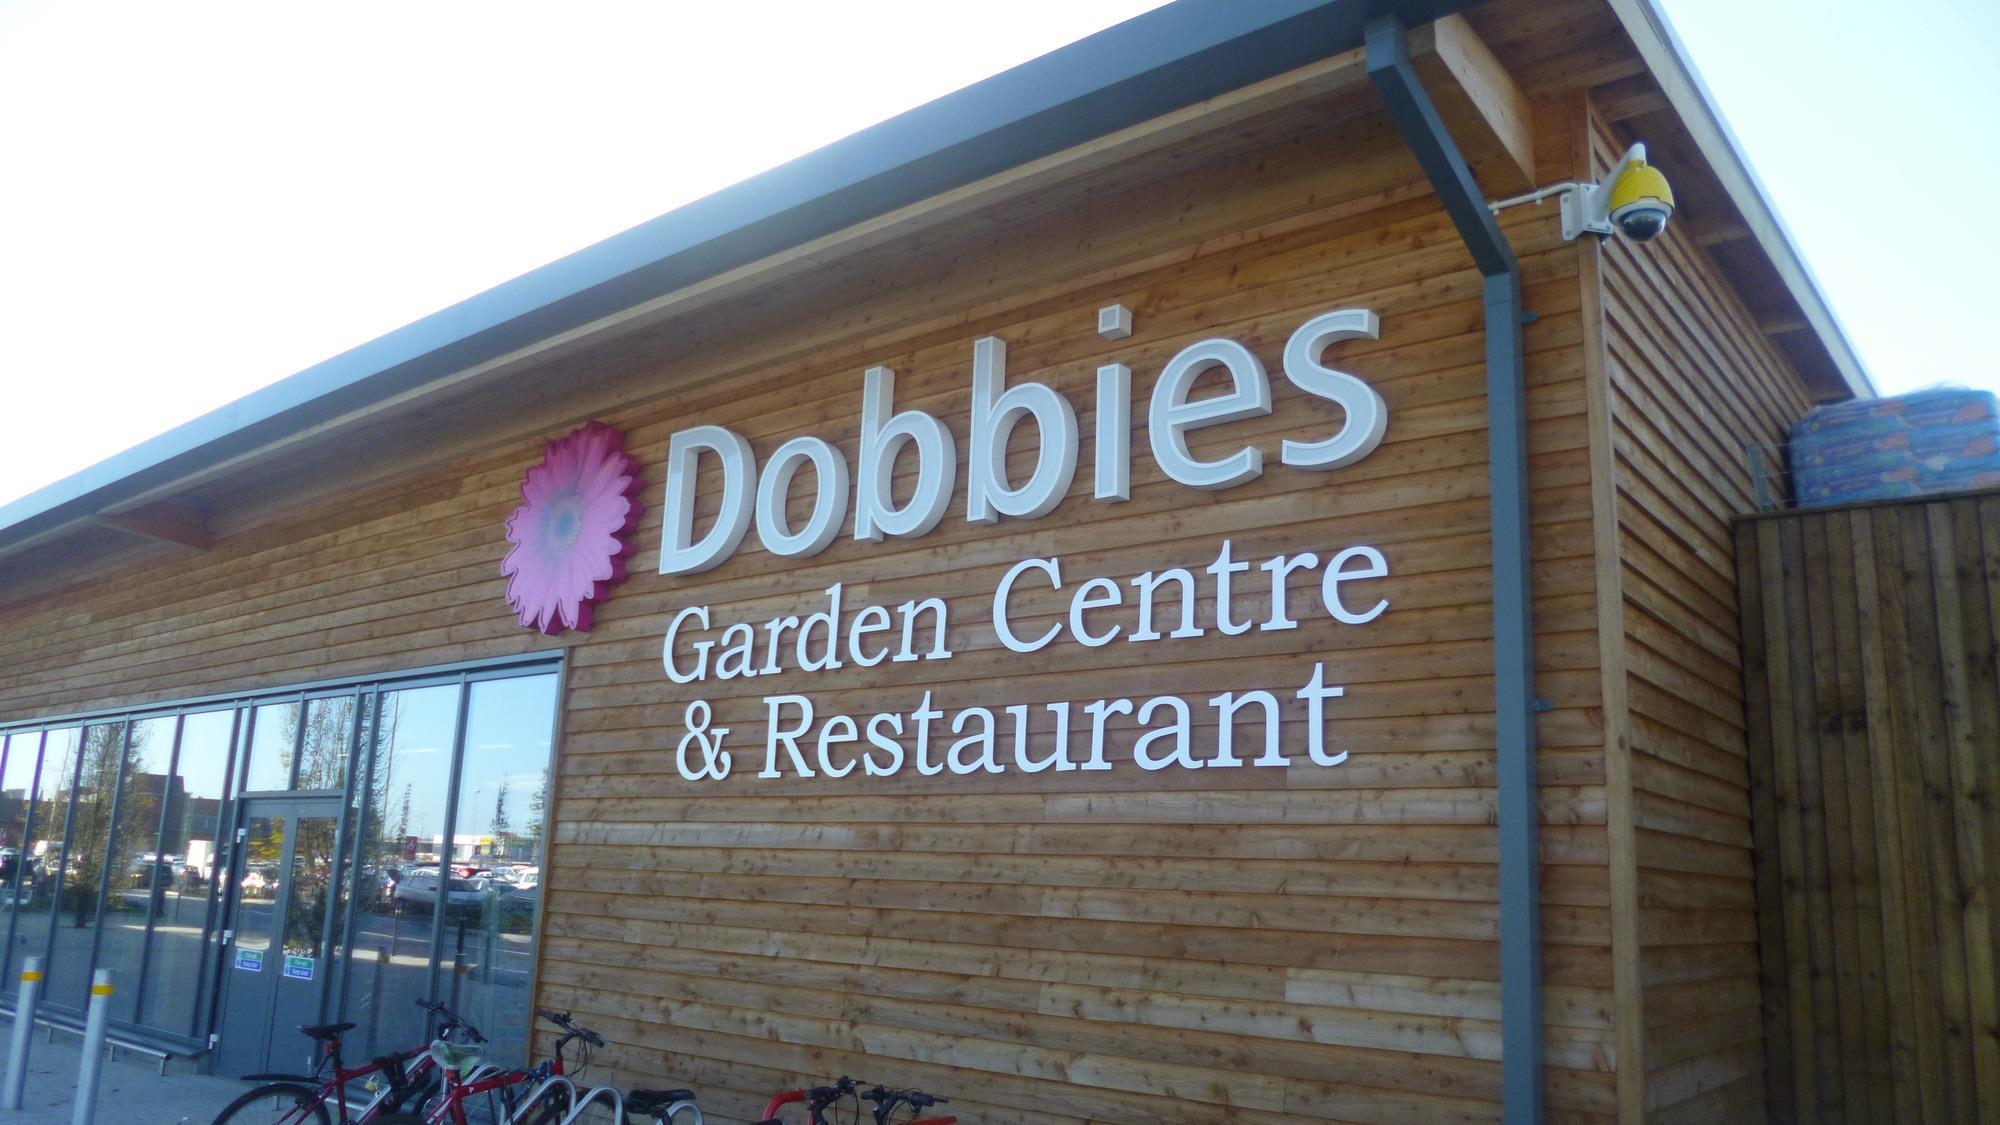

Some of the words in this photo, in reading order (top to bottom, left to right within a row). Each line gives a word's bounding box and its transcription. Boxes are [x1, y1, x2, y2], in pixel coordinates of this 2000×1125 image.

[659, 304, 1389, 576] Dobbies
[662, 582, 953, 684] Garden
[993, 539, 1389, 653] Centre
[676, 699, 732, 781] &
[758, 662, 1349, 779] Restaurant
